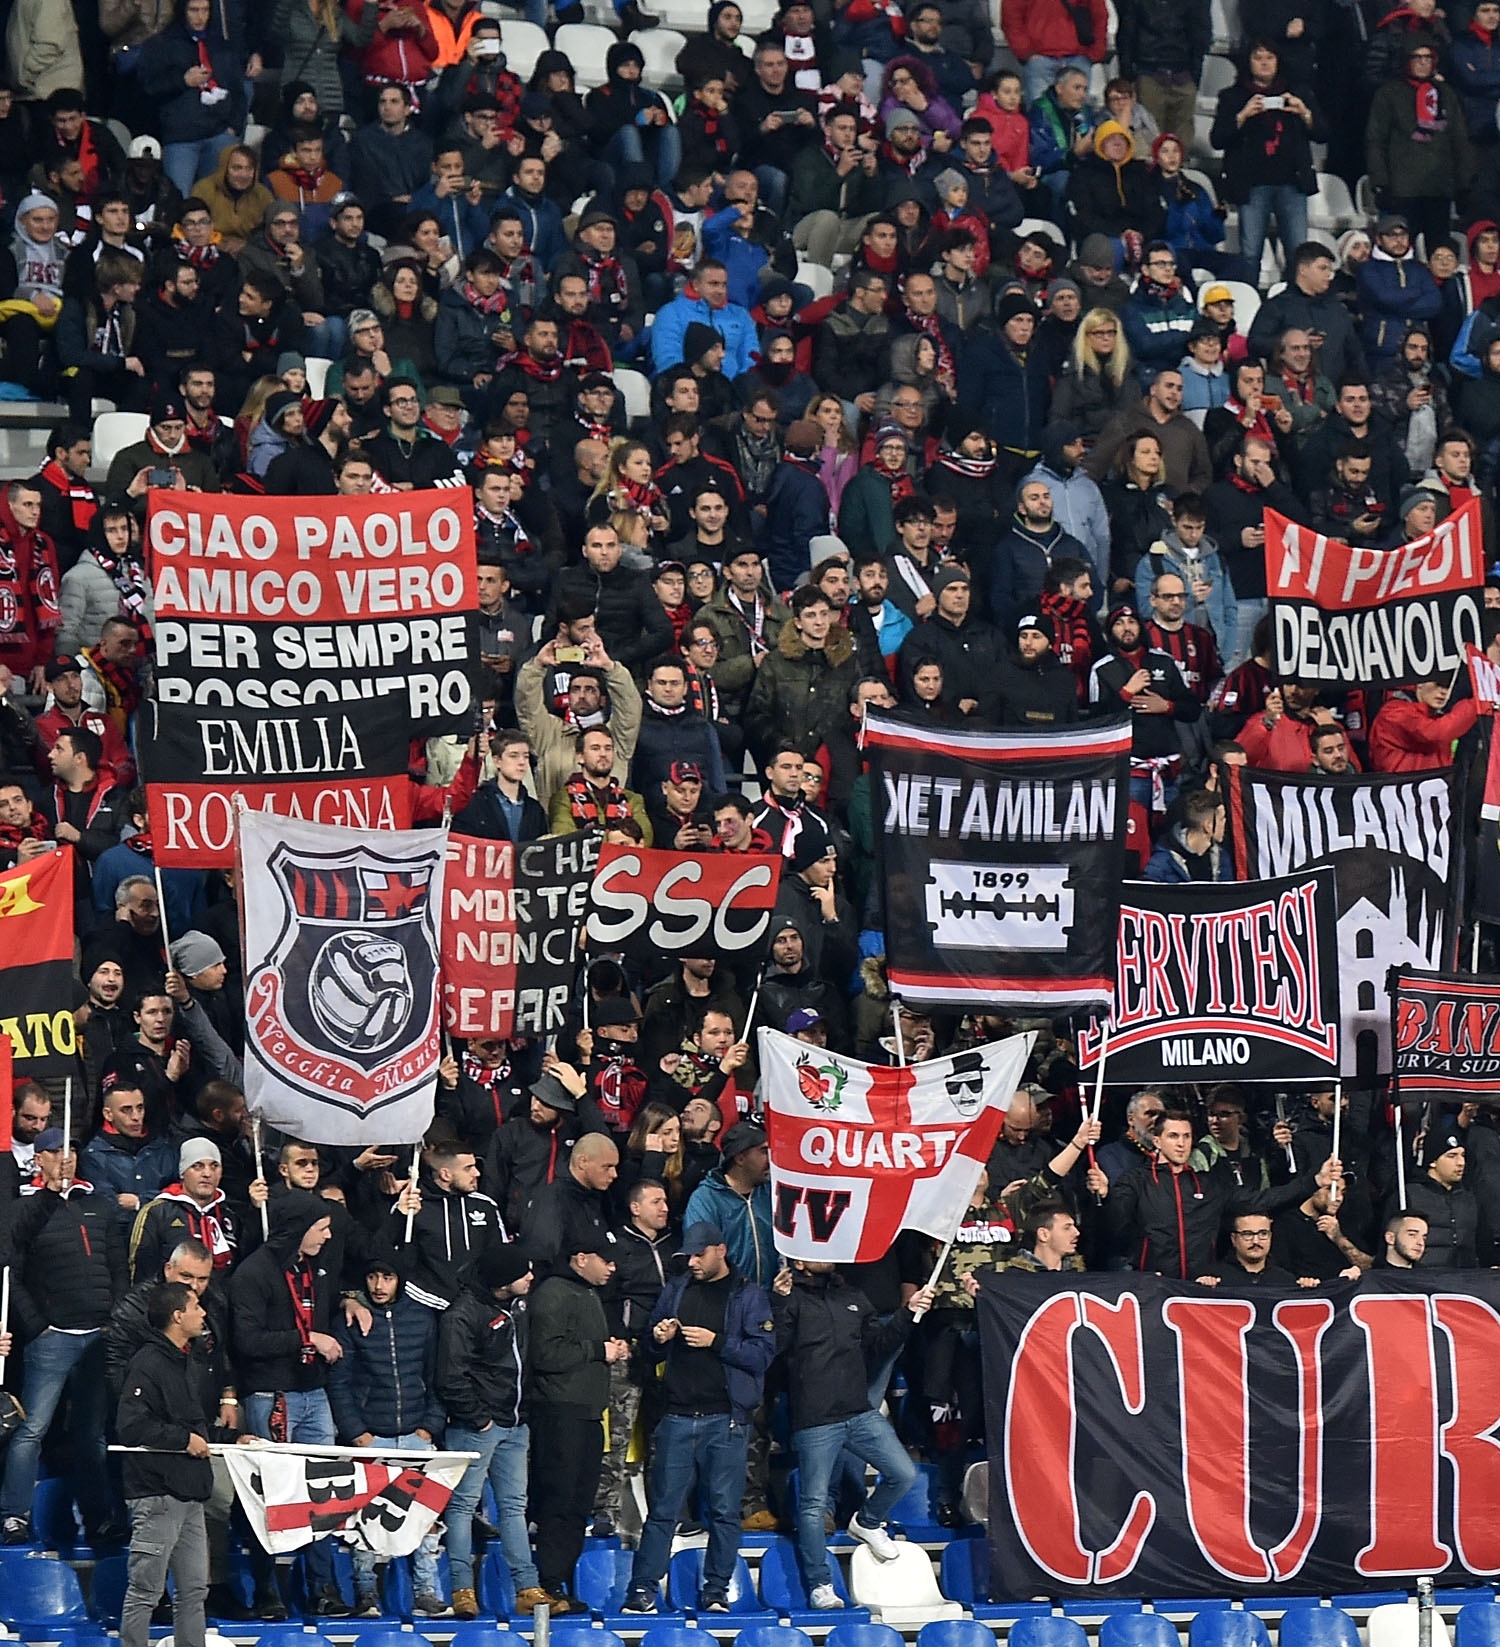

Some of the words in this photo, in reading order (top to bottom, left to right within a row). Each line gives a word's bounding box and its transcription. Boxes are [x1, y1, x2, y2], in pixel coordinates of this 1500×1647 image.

[150, 510, 278, 560] CIAO
[294, 507, 462, 560] PAOLO
[1278, 523, 1328, 597] AI
[1341, 512, 1474, 603] PIEDI
[155, 566, 323, 616] AMICO
[337, 562, 464, 613] VERO
[156, 622, 260, 669] PER
[273, 616, 468, 669] SEMPRE
[197, 714, 366, 776] EMILIA
[1251, 777, 1451, 884] MILANO
[450, 882, 589, 923] MORTE
[586, 854, 773, 950] SSC
[973, 871, 1030, 889] 1899
[1089, 880, 1324, 1038] ERVITESI
[257, 1015, 355, 1091] Vecchia
[1162, 1037, 1250, 1066] MILANO
[1460, 1058, 1500, 1074] SUD
[800, 1127, 971, 1169] QUART
[774, 1181, 852, 1242] IV
